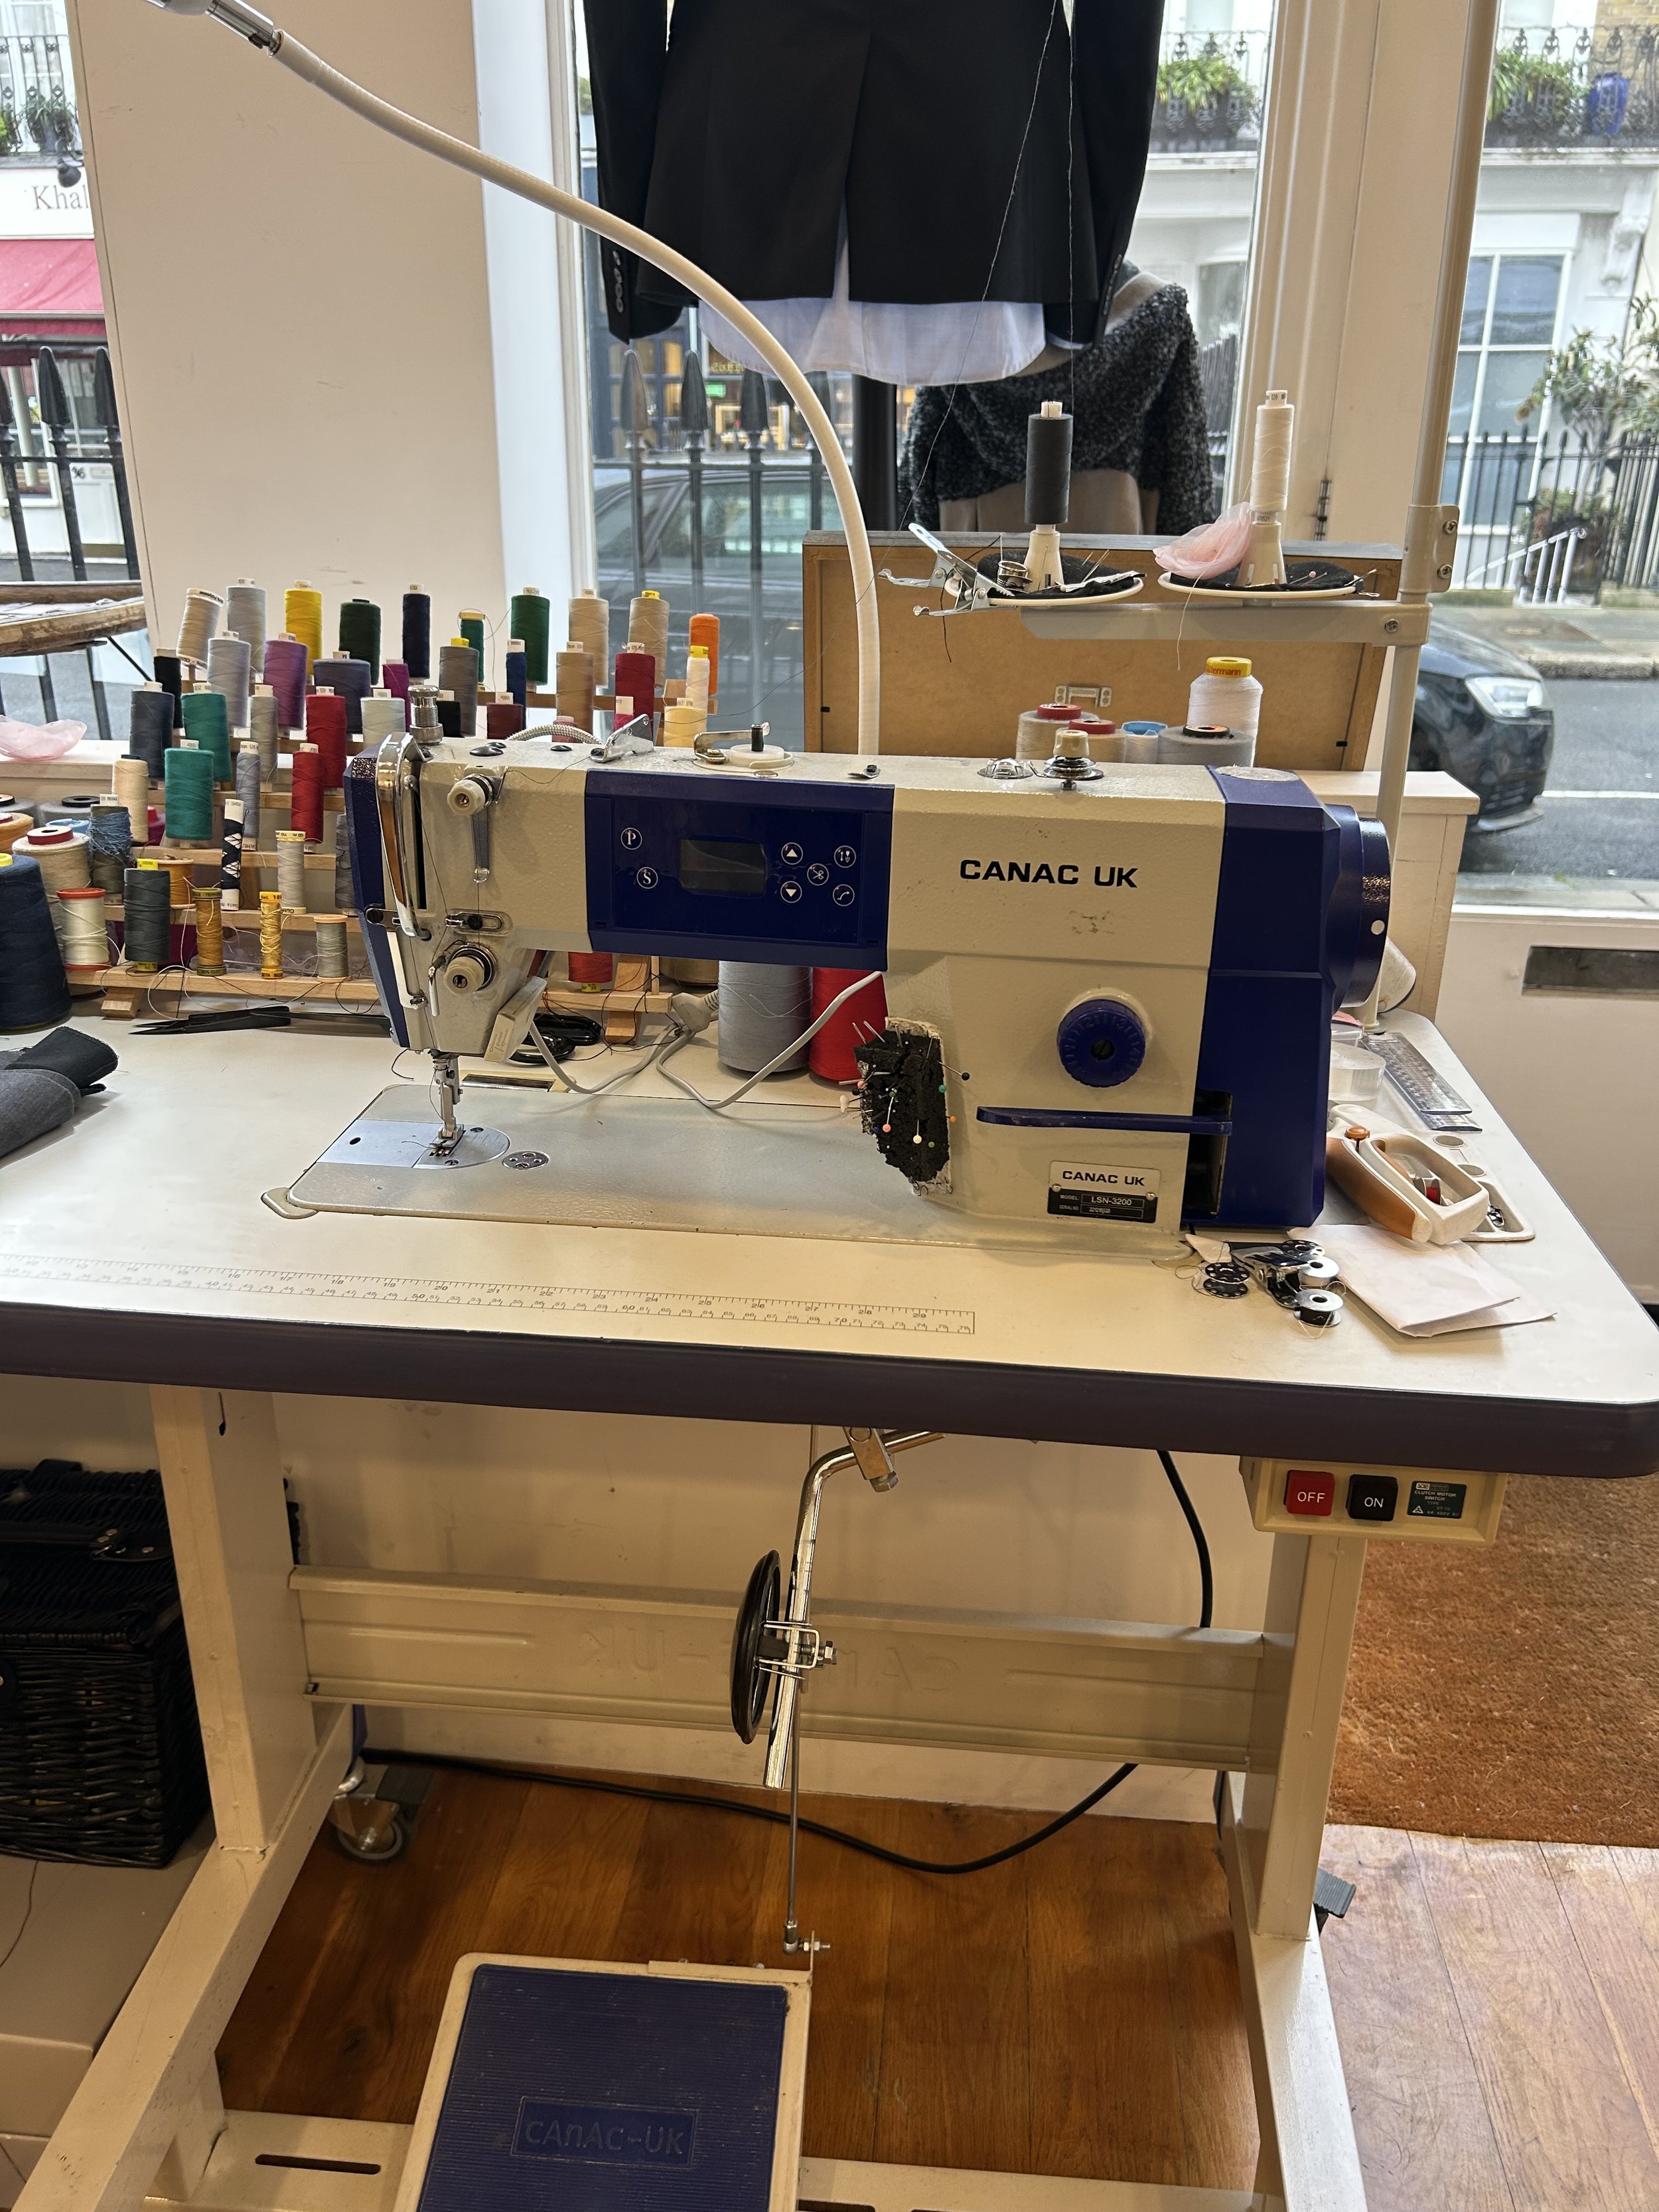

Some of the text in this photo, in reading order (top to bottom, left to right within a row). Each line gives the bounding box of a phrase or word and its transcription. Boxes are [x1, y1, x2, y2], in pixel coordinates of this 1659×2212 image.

[626, 830, 636, 845] P
[642, 870, 652, 885] S
[960, 859, 1138, 889] CANAC UK
[1062, 1171, 1145, 1186] CANAC UK
[1091, 1197, 1132, 1206] LSN-3200
[1297, 1491, 1326, 1503] OFF
[1364, 1497, 1384, 1509] ON
